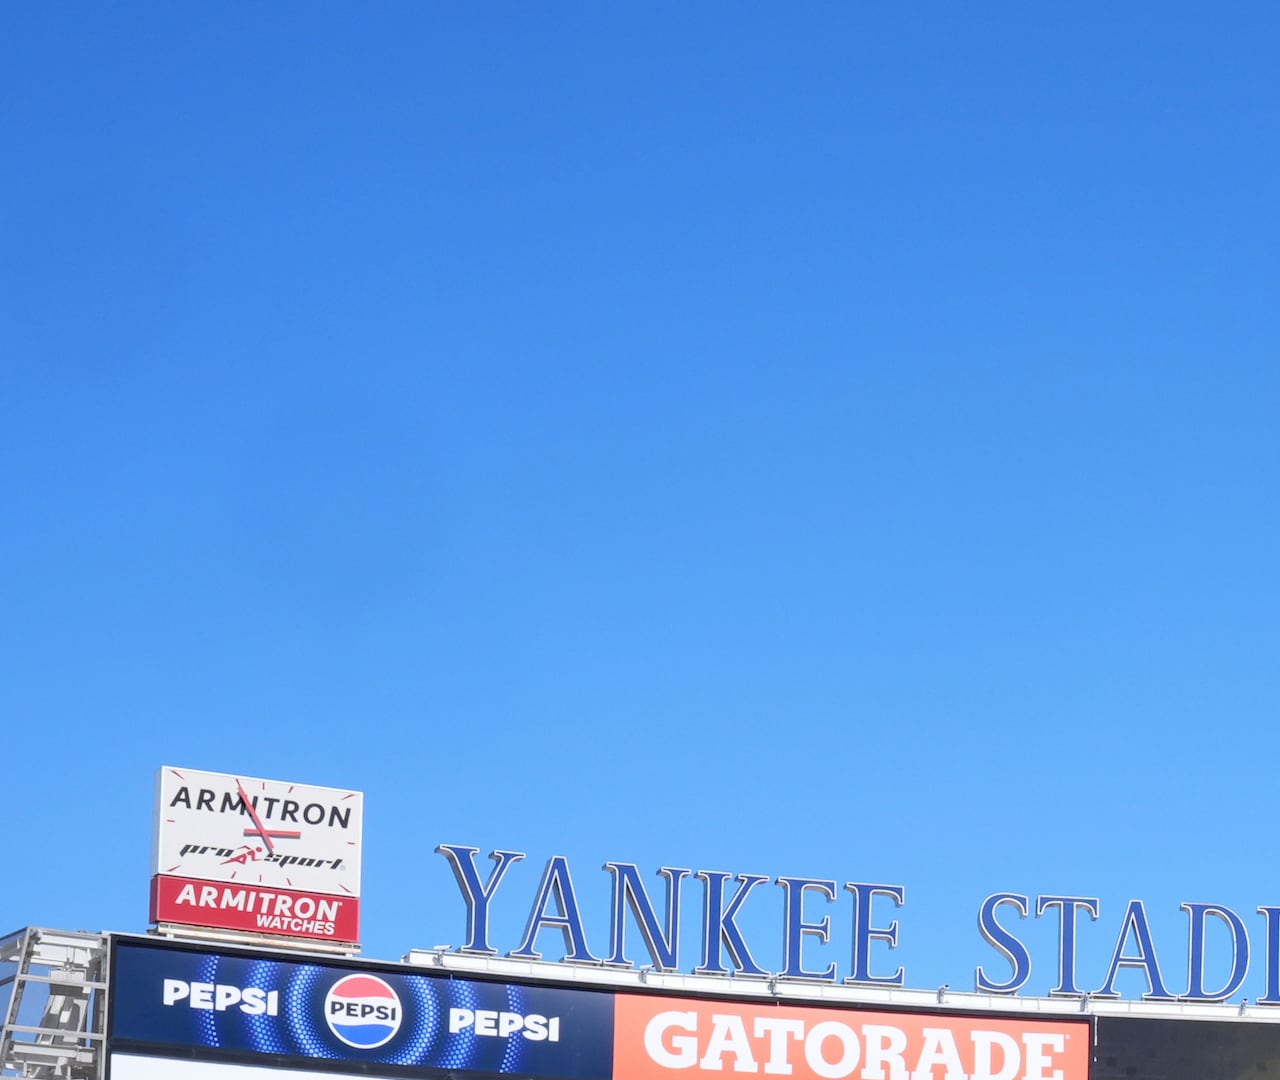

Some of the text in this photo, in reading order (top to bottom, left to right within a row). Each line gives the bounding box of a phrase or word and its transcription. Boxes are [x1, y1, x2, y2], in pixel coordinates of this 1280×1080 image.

[170, 786, 351, 829] ARMITRON
[180, 844, 344, 869] pro sport
[175, 884, 339, 921] ARMITRON
[434, 843, 906, 986] YANKEE
[256, 915, 336, 935] WATCHES
[163, 979, 278, 1016] PEPSI
[330, 1000, 397, 1023] PEPSI
[449, 1007, 560, 1042] PEPSI
